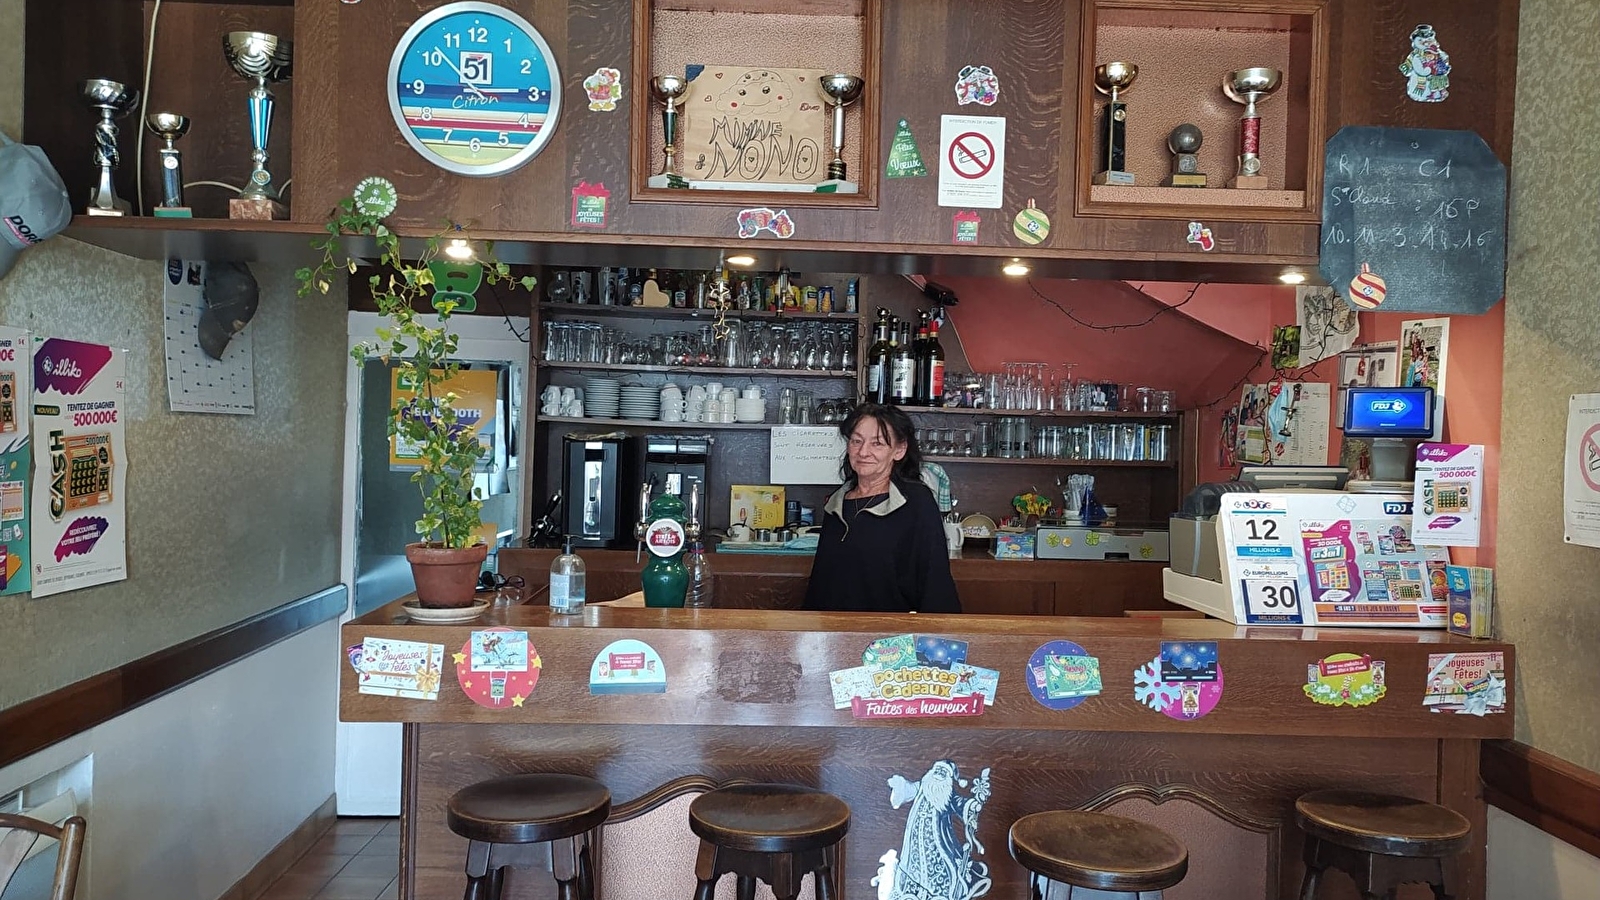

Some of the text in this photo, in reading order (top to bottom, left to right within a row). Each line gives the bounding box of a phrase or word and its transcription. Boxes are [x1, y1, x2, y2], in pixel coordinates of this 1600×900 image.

[443, 32, 461, 49] 11
[467, 27, 488, 43] 12
[504, 38, 512, 53] 1
[422, 51, 442, 66] 10
[520, 59, 532, 74] 2
[463, 57, 488, 81] 51
[413, 79, 425, 95] 9
[528, 86, 540, 102] 3
[452, 94, 499, 109] Citron
[421, 106, 433, 121] 8
[518, 113, 530, 128] 4
[442, 128, 453, 143] 7
[497, 132, 509, 146] 5
[469, 137, 481, 153] 6
[703, 134, 820, 181] NONO
[52, 357, 83, 378] illiko
[67, 400, 115, 412] TENTEZ DE GAGNER
[1373, 402, 1391, 410] FDJ
[49, 429, 65, 518] CASH
[1423, 479, 1435, 516] CASH
[1386, 503, 1407, 513] FDJ
[1245, 518, 1279, 541] 12
[1261, 585, 1296, 609] 30
[881, 682, 951, 699] Cadeaux
[866, 701, 903, 716] Faites
[905, 705, 918, 715] des
[920, 700, 968, 715] heureux
